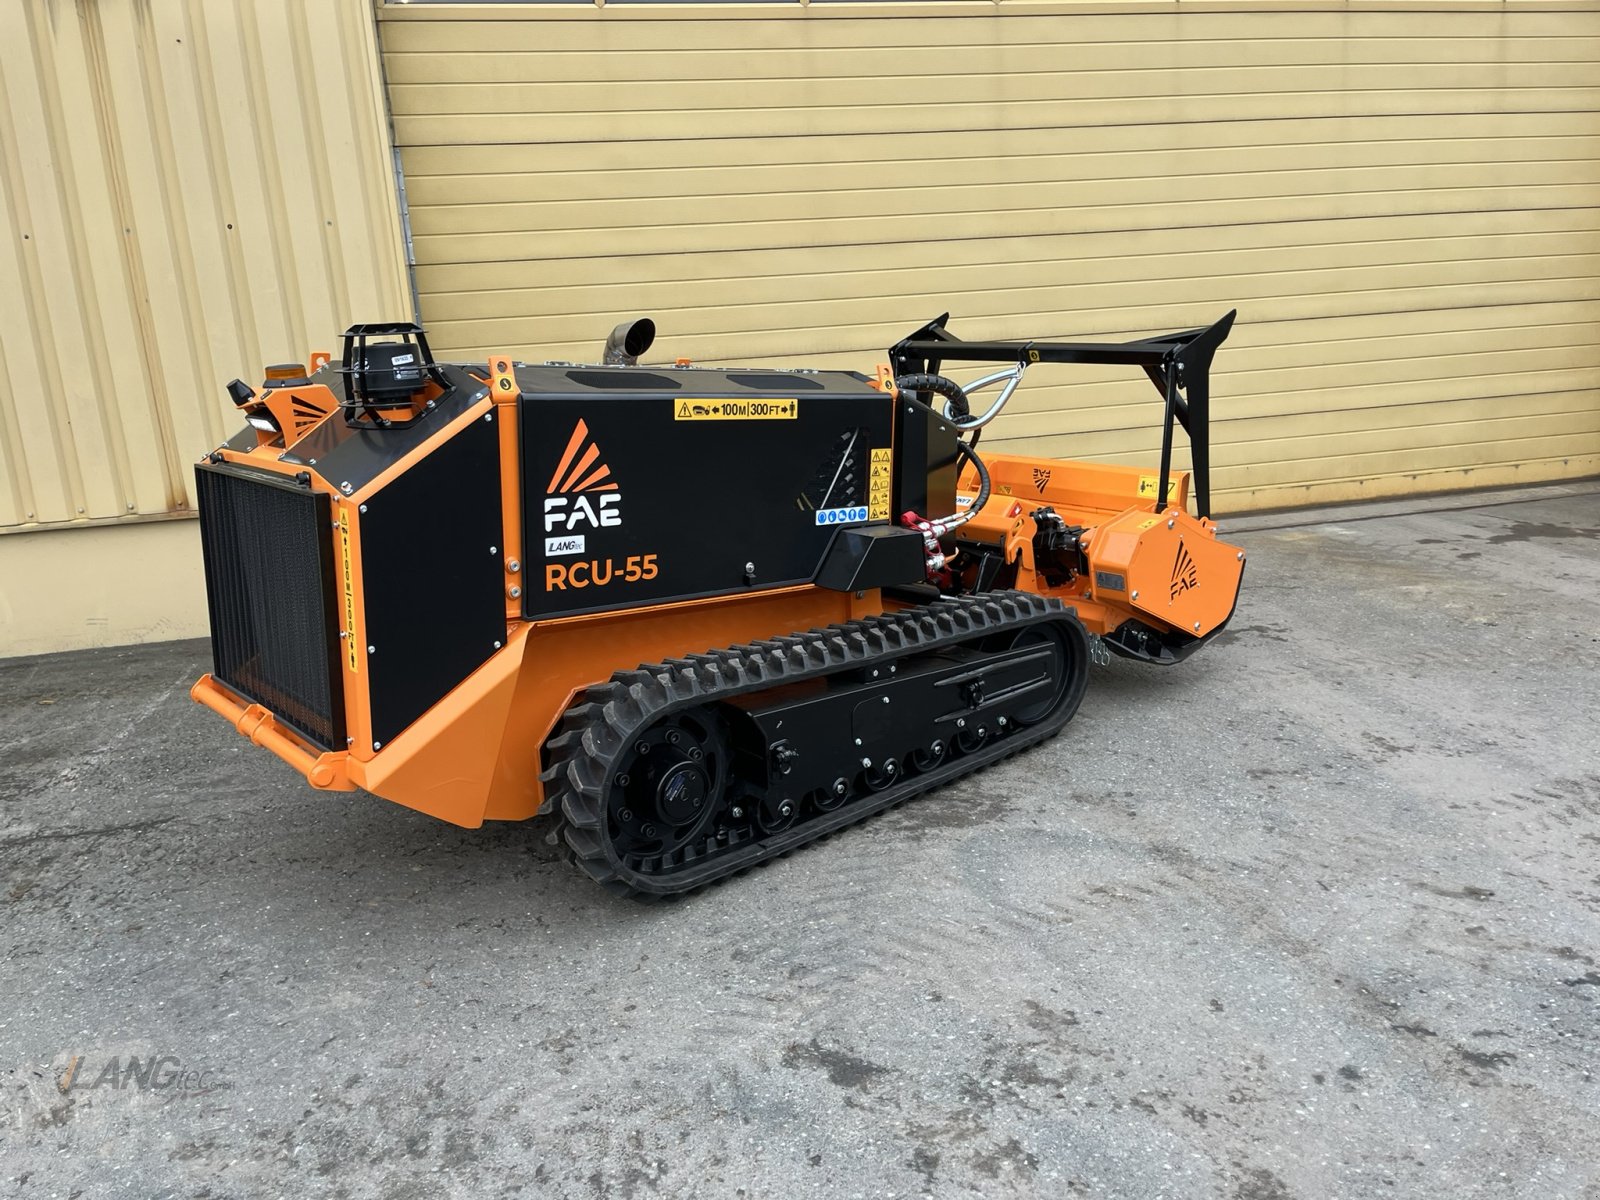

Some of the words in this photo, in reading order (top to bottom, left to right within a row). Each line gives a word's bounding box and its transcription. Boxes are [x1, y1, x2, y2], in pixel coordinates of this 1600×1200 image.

[544, 493, 622, 532] FAE
[546, 554, 659, 592] RCU-55
[1170, 569, 1198, 601] FAE
